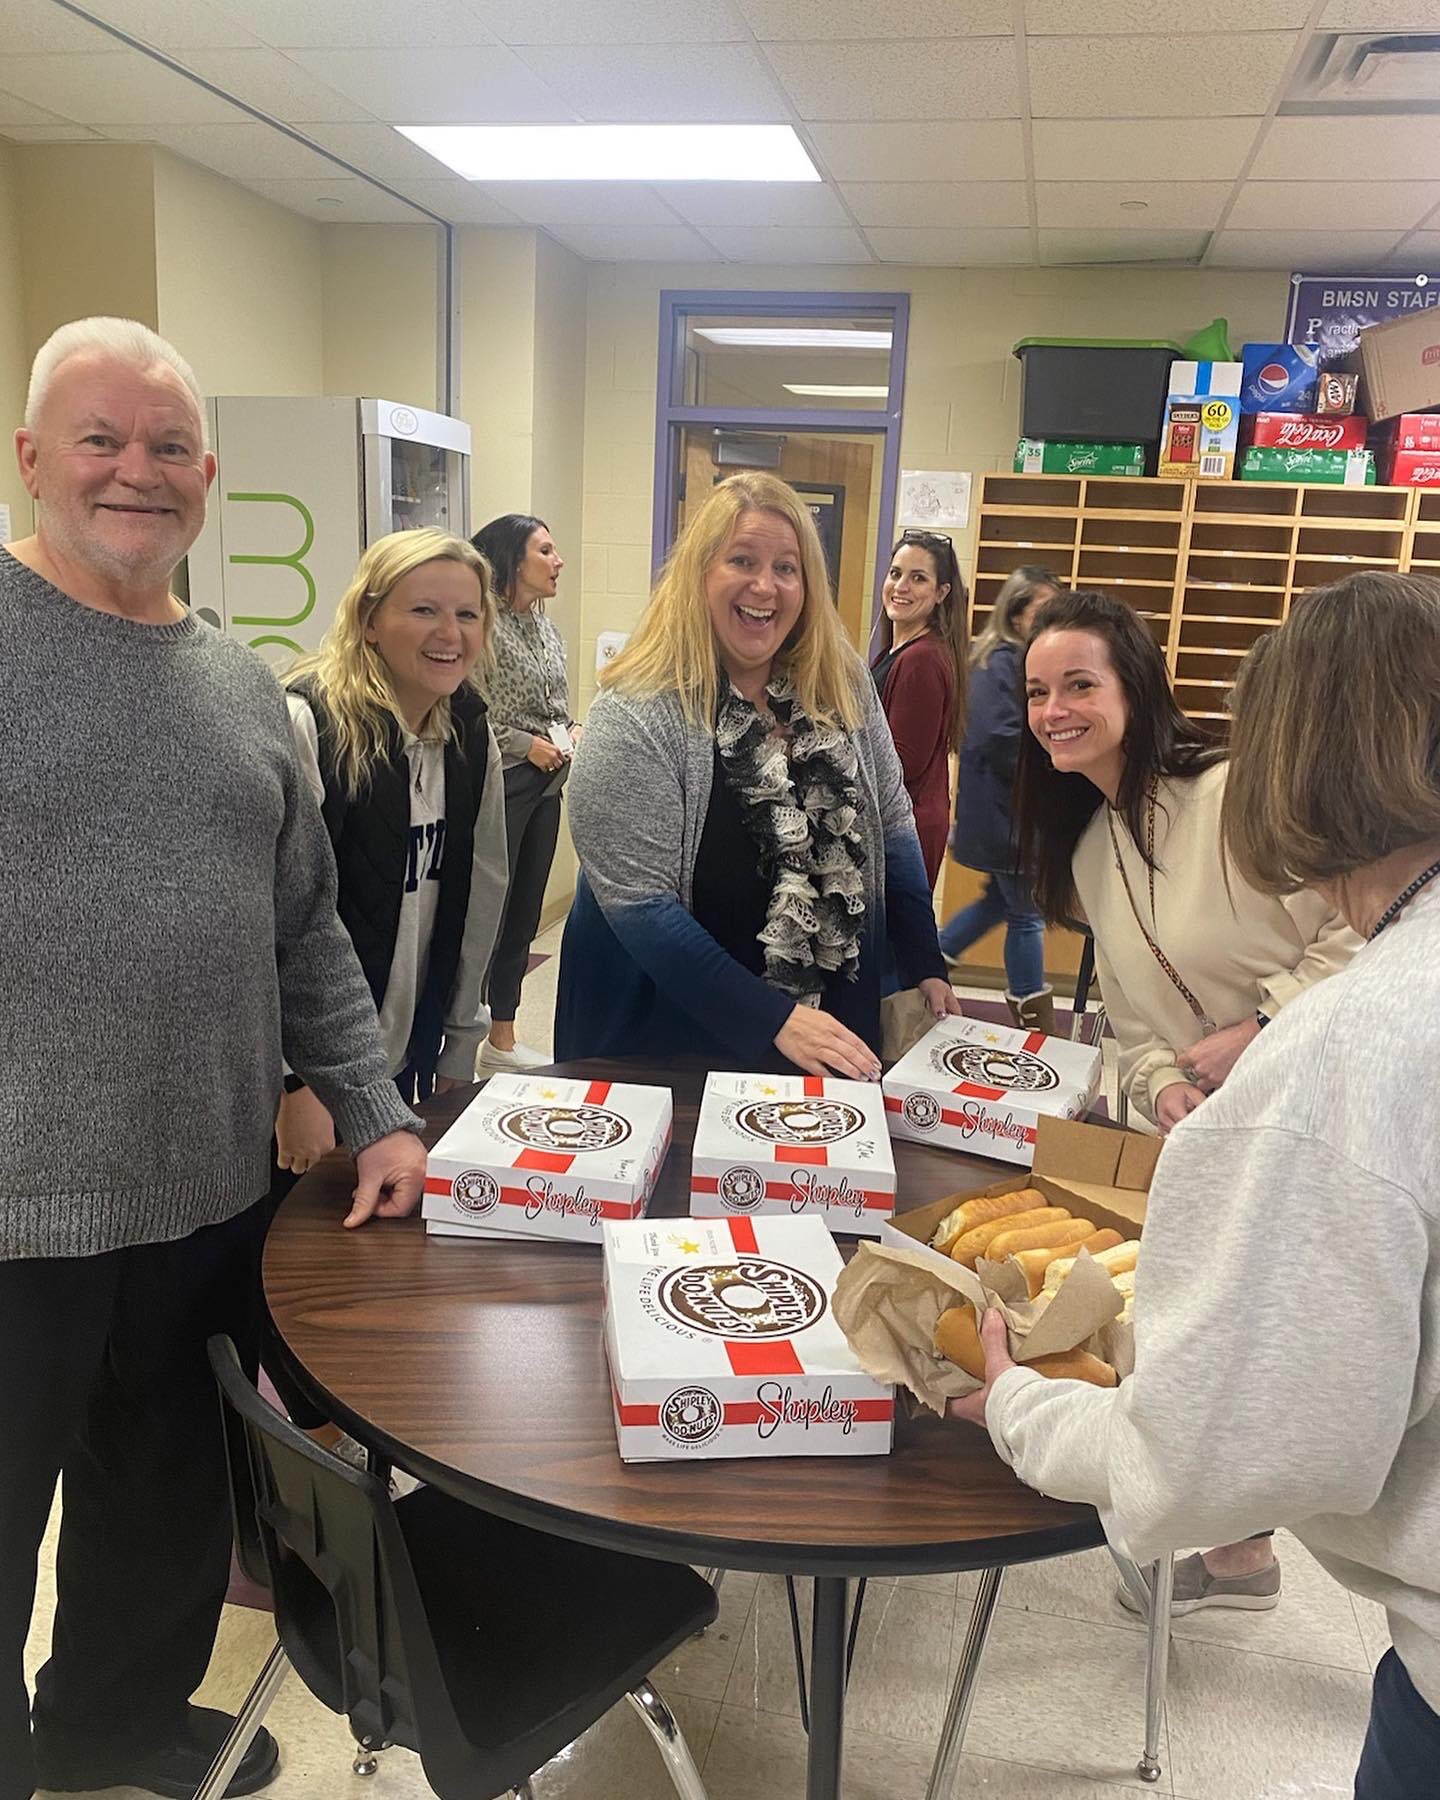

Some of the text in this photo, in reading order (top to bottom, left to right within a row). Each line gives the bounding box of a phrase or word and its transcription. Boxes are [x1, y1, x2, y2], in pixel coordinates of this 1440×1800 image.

[1322, 290, 1379, 308] BMSN
[1207, 404, 1228, 417] 60
[1275, 422, 1345, 448] Coca-Cola
[961, 1101, 1030, 1150] Shipley
[525, 1176, 604, 1226] Shipley
[790, 1169, 869, 1218] Shipley
[639, 1276, 654, 1295] LIFE
[739, 1266, 804, 1325] SHIPLEY
[640, 1296, 697, 1340] DELICIOUS
[669, 1396, 713, 1414] SHIPLEY
[757, 1381, 857, 1439] Shipley
